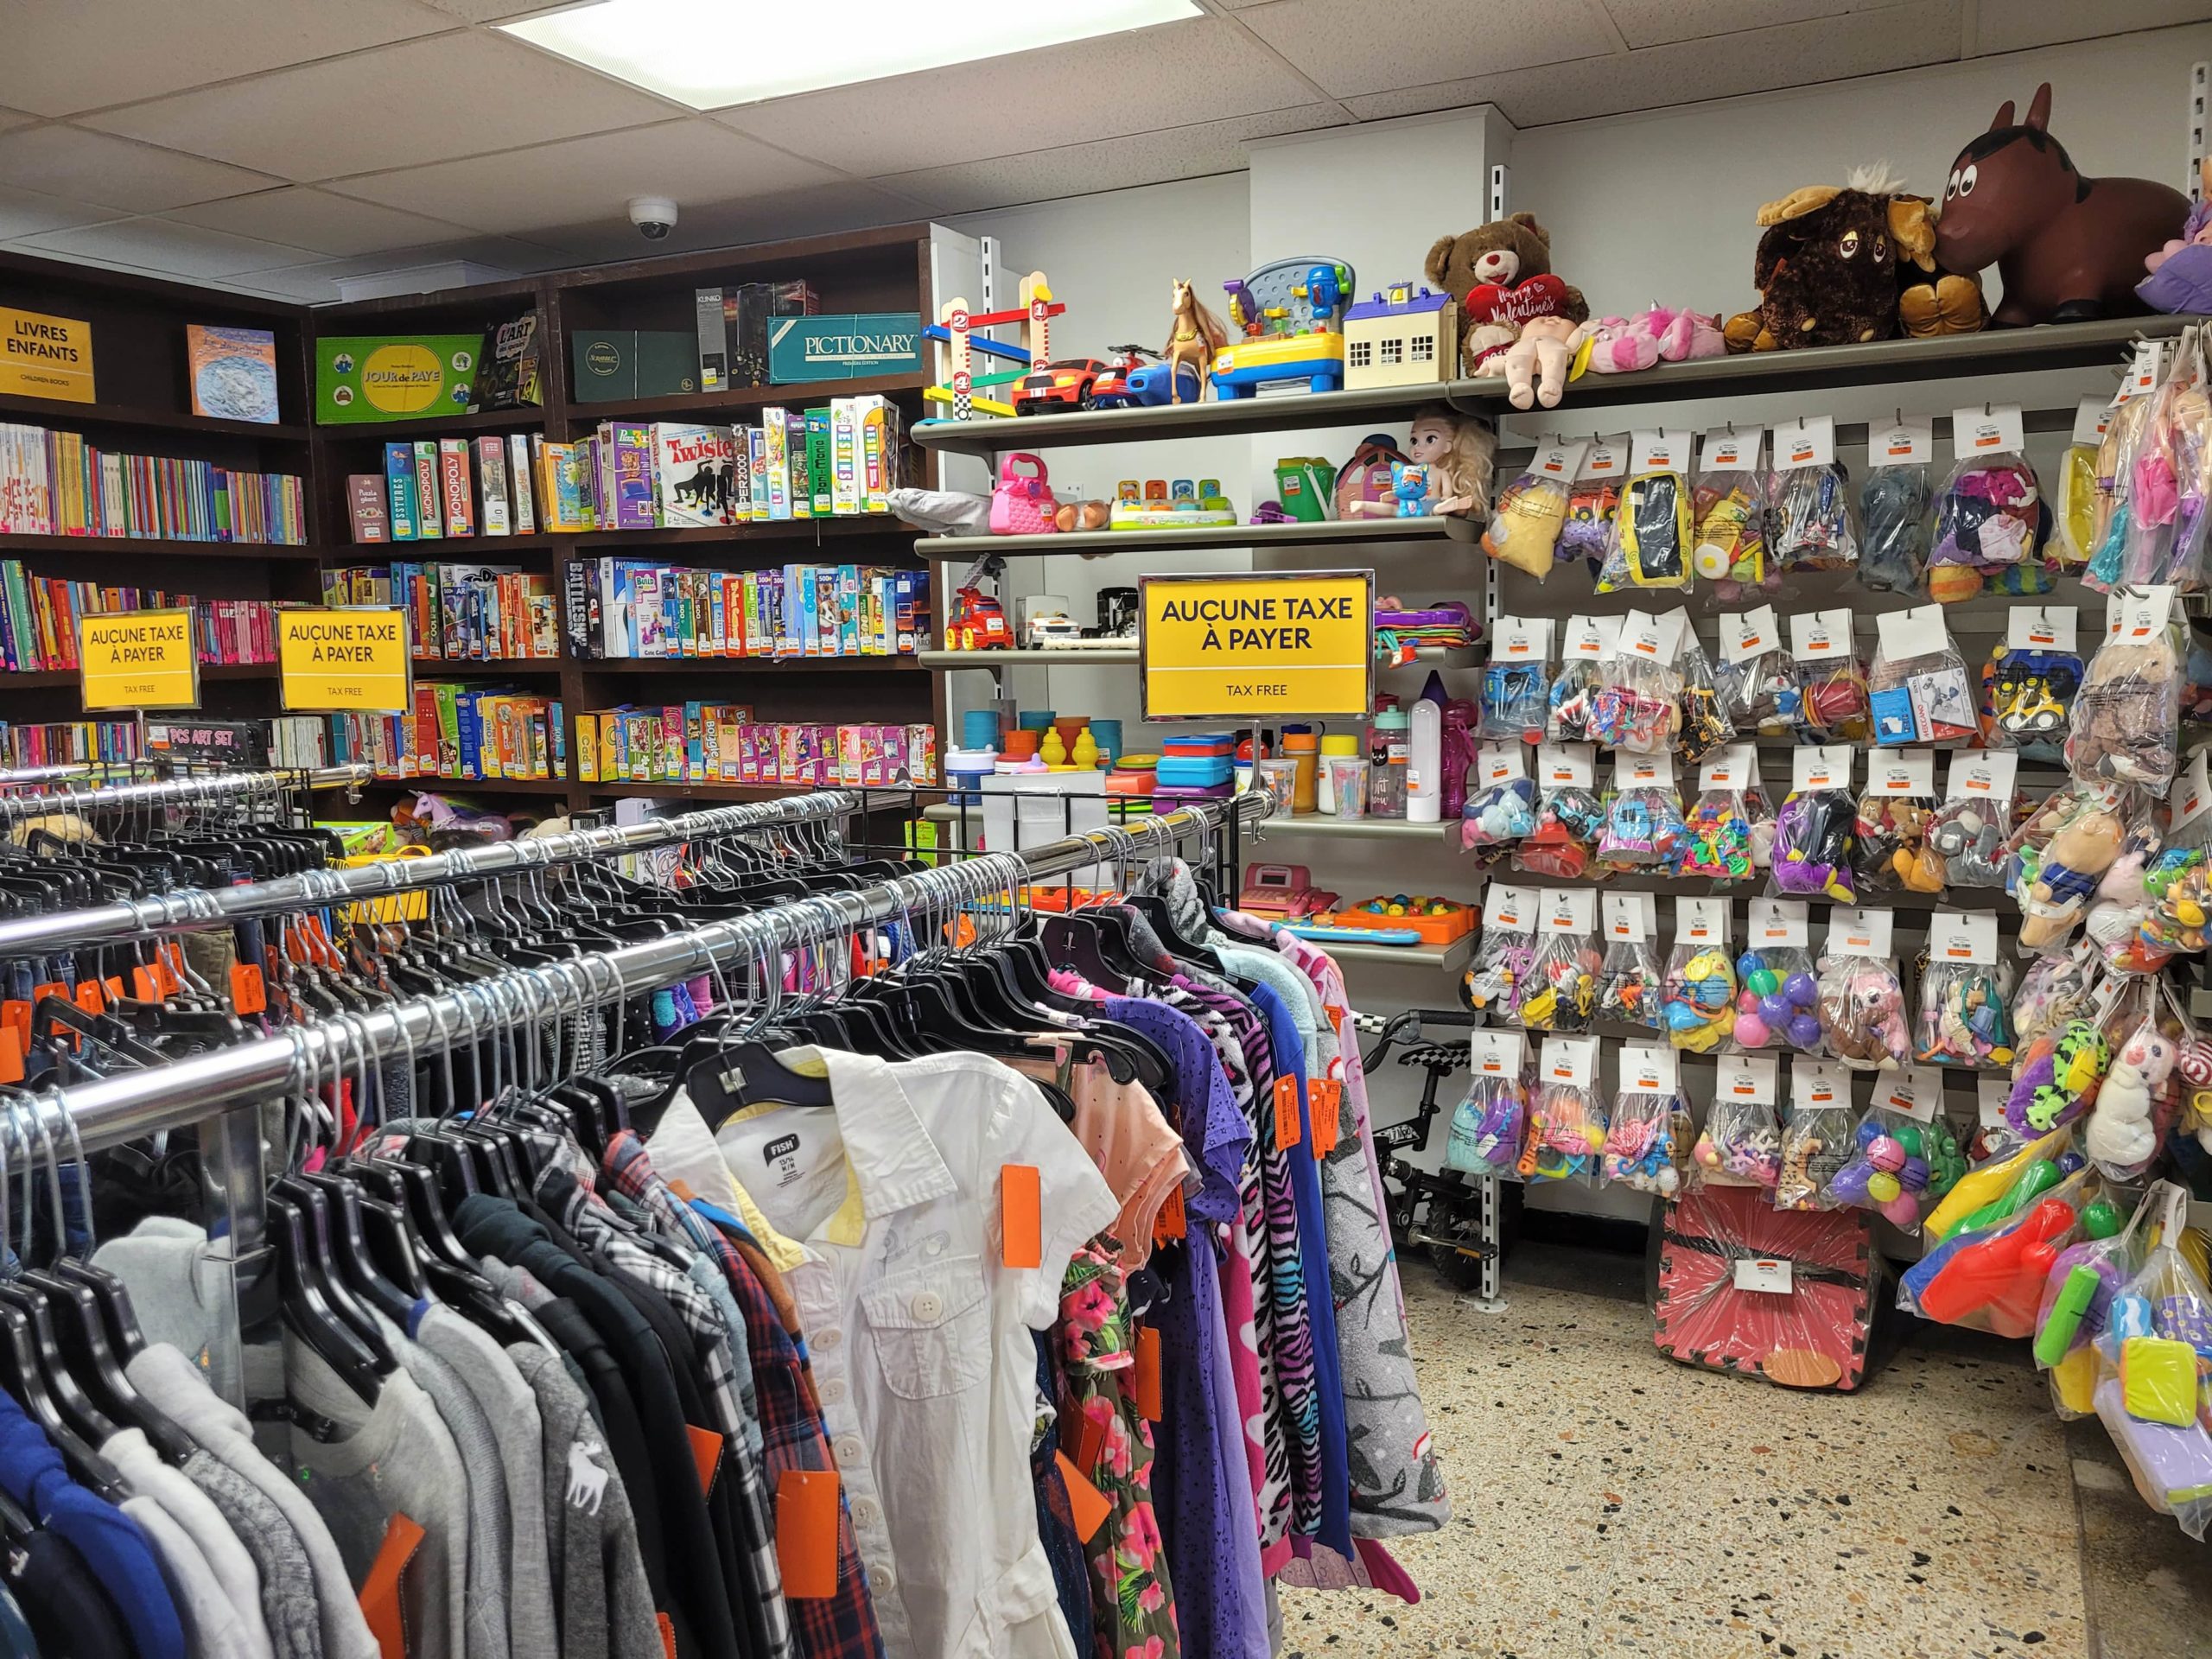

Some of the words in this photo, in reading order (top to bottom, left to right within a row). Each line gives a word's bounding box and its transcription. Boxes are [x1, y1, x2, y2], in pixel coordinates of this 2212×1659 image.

[1497, 284, 1533, 304] Happy
[1035, 305, 1045, 317] 1
[1491, 296, 1555, 322] Valentine's
[15, 320, 68, 342] LIVRES
[954, 316, 967, 329] 2
[7, 338, 79, 362] ENFANTS
[804, 334, 915, 355] PICTIONARY
[20, 374, 48, 384] CHILDREN
[365, 372, 398, 383] JOUR
[398, 373, 410, 382] de
[410, 370, 440, 382] PAYE
[955, 377, 968, 390] 4
[837, 425, 854, 480] DESTINS
[865, 425, 879, 467] DESTINS
[420, 461, 435, 516] MONOPOLY
[448, 456, 463, 518] MONOPOLY
[771, 471, 784, 504] LIFE
[803, 579, 817, 613] 500
[1160, 599, 1276, 621] AUCUNE
[1283, 597, 1352, 620] TAXE
[90, 627, 145, 645] AUCUNE
[149, 626, 184, 641] TAXE
[289, 625, 353, 641] AUCUNE
[357, 625, 396, 641] TAXE
[1201, 622, 1222, 650] À
[1230, 627, 1313, 650] PAYER
[111, 645, 121, 664] À
[124, 646, 165, 663] PAYER
[312, 641, 324, 662] À
[327, 646, 374, 662] PAYER
[124, 685, 138, 694] TAX
[139, 684, 156, 693] FREE
[327, 687, 343, 696] TAX
[344, 687, 363, 696] FREE
[1226, 685, 1252, 696] TAX
[1257, 684, 1287, 696] FREE
[1917, 704, 1929, 739] MECCANO
[169, 728, 190, 744] PCS
[193, 729, 213, 745] ART
[214, 730, 234, 746] SET
[704, 720, 720, 760] Boggle
[770, 1140, 794, 1155] FISH
